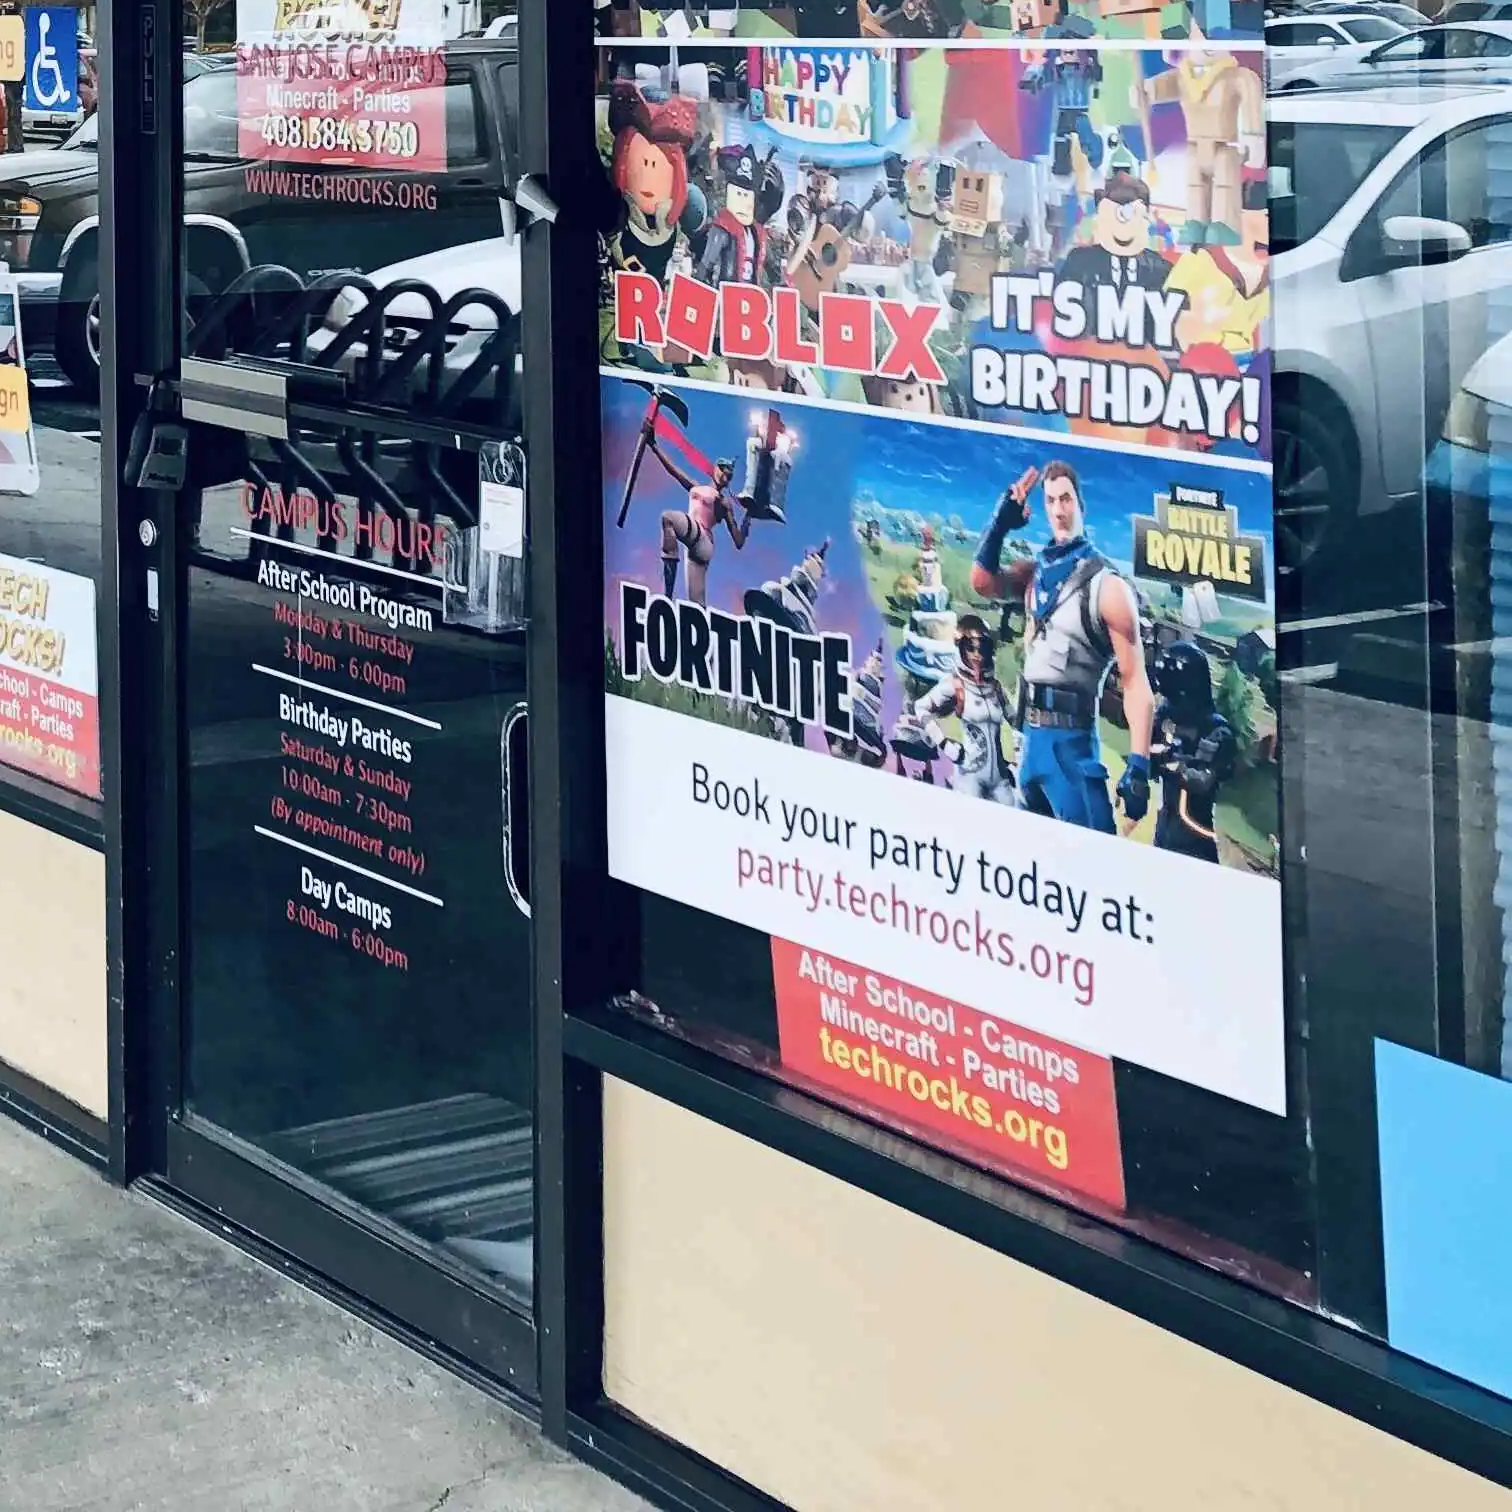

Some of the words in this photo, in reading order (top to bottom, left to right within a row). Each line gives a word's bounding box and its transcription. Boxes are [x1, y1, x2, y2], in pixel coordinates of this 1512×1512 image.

[143, 16, 154, 102] PULL
[763, 49, 850, 96] HAPPY
[266, 84, 338, 112] Minecraft
[353, 87, 411, 114] Parties
[245, 168, 438, 210] WWW.TECHROCKS.ORG
[614, 270, 949, 387] ROBLOX
[990, 272, 1087, 339] IT'S
[1096, 283, 1191, 353] MY
[971, 344, 1261, 444] BIRTHDAY!
[243, 483, 348, 541] CAMPUS
[1146, 529, 1252, 585] ROYALE
[257, 560, 297, 591] After
[300, 568, 355, 611] School
[359, 586, 433, 632] Program
[272, 600, 327, 640] Monday
[331, 618, 341, 640] &
[347, 622, 414, 664] Thursday
[283, 636, 336, 674] 3:00pm
[349, 656, 406, 695] 6:00pm
[619, 581, 855, 739] FORTNITE
[31, 706, 74, 741] Parties
[40, 683, 83, 719] Camps
[279, 693, 348, 746] Birthday
[352, 717, 412, 764] Parties
[280, 732, 339, 775] Saturday
[344, 756, 354, 776] &
[359, 760, 411, 801] Sunday
[281, 765, 341, 806] 10:00am
[356, 793, 411, 833] 7:30pm
[271, 796, 291, 823] (By
[295, 809, 382, 857] appointment
[388, 845, 425, 876] only)
[692, 762, 770, 825] Book
[780, 800, 857, 843] your
[869, 826, 964, 894] party
[977, 850, 1087, 933] today
[1102, 895, 1155, 945] at:
[301, 866, 332, 909] Day
[335, 882, 392, 929] Camps
[737, 845, 1096, 1007] party.techrocks.org
[286, 900, 339, 940] 8:00am
[352, 928, 408, 970] 6:00pm
[798, 950, 859, 1000] After
[865, 974, 956, 1035] School
[981, 1020, 1079, 1085] Camps
[820, 994, 939, 1067] Minecraft
[963, 1049, 1061, 1115] Parties
[819, 1028, 1070, 1171] techrocks.org
